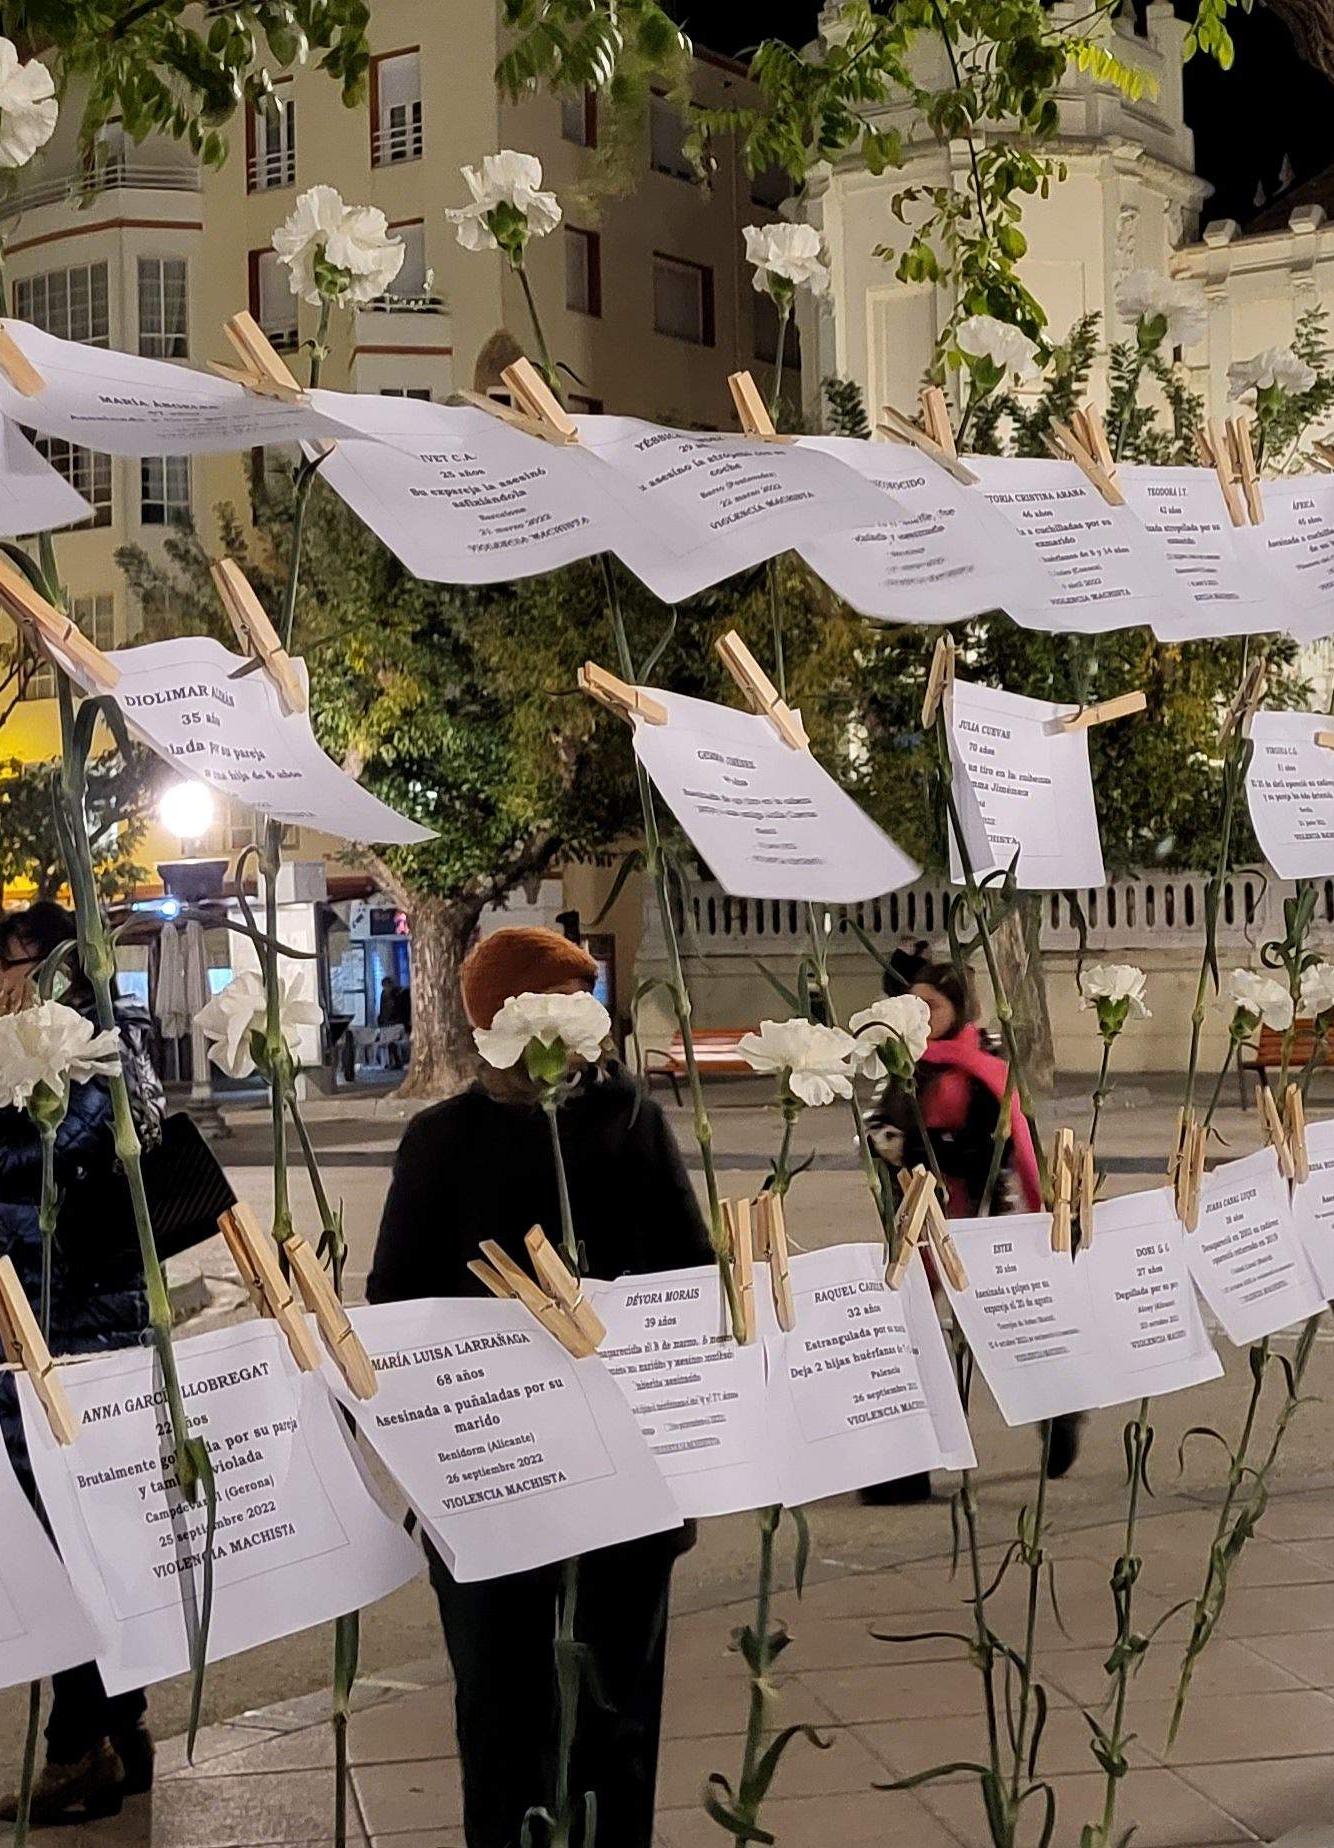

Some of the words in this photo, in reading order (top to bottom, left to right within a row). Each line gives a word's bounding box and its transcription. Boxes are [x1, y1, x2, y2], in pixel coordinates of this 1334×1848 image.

[1015, 493, 1055, 502] CRISTINA
[1056, 489, 1086, 499] ARANA
[125, 685, 208, 706] DIOLIMAR
[182, 712, 201, 725] 35
[959, 720, 979, 732] JULIA
[982, 726, 1010, 739] CUEVAS
[980, 766, 993, 775] tiro
[625, 1293, 663, 1307] DÉVORA
[665, 1288, 699, 1302] MORAIS
[815, 1285, 856, 1303] RAQUEL
[645, 1318, 656, 1328] 39
[658, 1316, 676, 1326] años
[847, 1307, 861, 1318] 32
[413, 1346, 453, 1364] LUISA
[455, 1334, 530, 1355] LARRAÑAGA
[805, 1328, 871, 1351] Estrangulada
[791, 1366, 813, 1378] Deja
[825, 1358, 851, 1369] hijas
[853, 1347, 896, 1362] huérfanas
[437, 1374, 452, 1386] 68
[456, 1369, 484, 1382] años
[82, 1403, 121, 1424] ANNA
[182, 1362, 269, 1398] LLOBREGAT
[376, 1405, 440, 1426] Asesinada
[455, 1388, 520, 1414] puñaladas
[524, 1383, 544, 1398] por
[847, 1406, 900, 1425] VIOLENCIA
[454, 1414, 500, 1433] marido
[77, 1460, 156, 1488] Brutalmente
[225, 1432, 249, 1450] por
[254, 1427, 269, 1438] su
[272, 1420, 297, 1436] pareja
[438, 1446, 486, 1462] Benidorm
[487, 1432, 535, 1453] (Alicante)
[446, 1473, 460, 1484] 26
[462, 1459, 518, 1481] septiembre
[517, 1454, 543, 1467] 2022
[225, 1475, 274, 1501] (Gerona)
[442, 1488, 504, 1509] VIOLENCIA
[505, 1472, 566, 1495] MACHISTA
[159, 1530, 176, 1547] 25
[246, 1501, 276, 1519] 2022
[229, 1523, 295, 1553] MACHISTA
